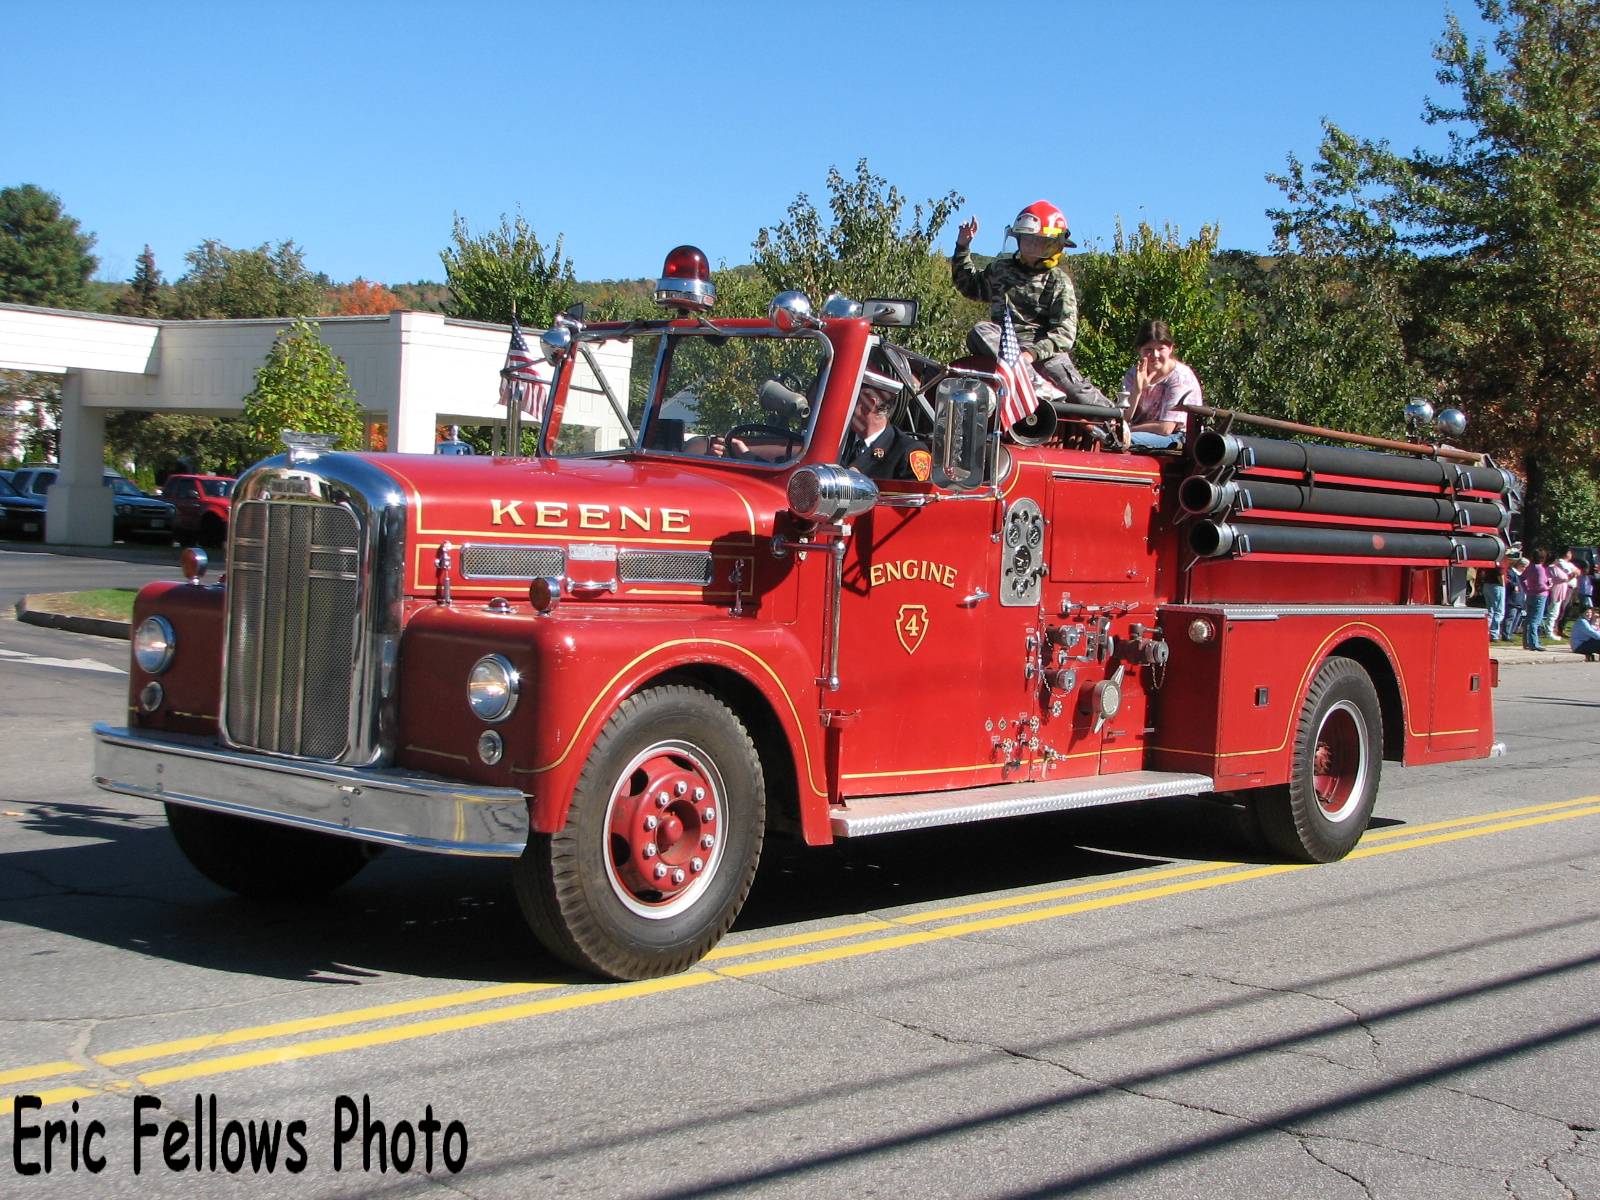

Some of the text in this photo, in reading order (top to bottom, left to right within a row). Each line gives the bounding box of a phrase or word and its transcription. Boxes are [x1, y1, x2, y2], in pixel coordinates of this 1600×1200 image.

[490, 498, 691, 533] KEENE
[870, 559, 958, 588] ENGINE
[904, 613, 919, 637] 4
